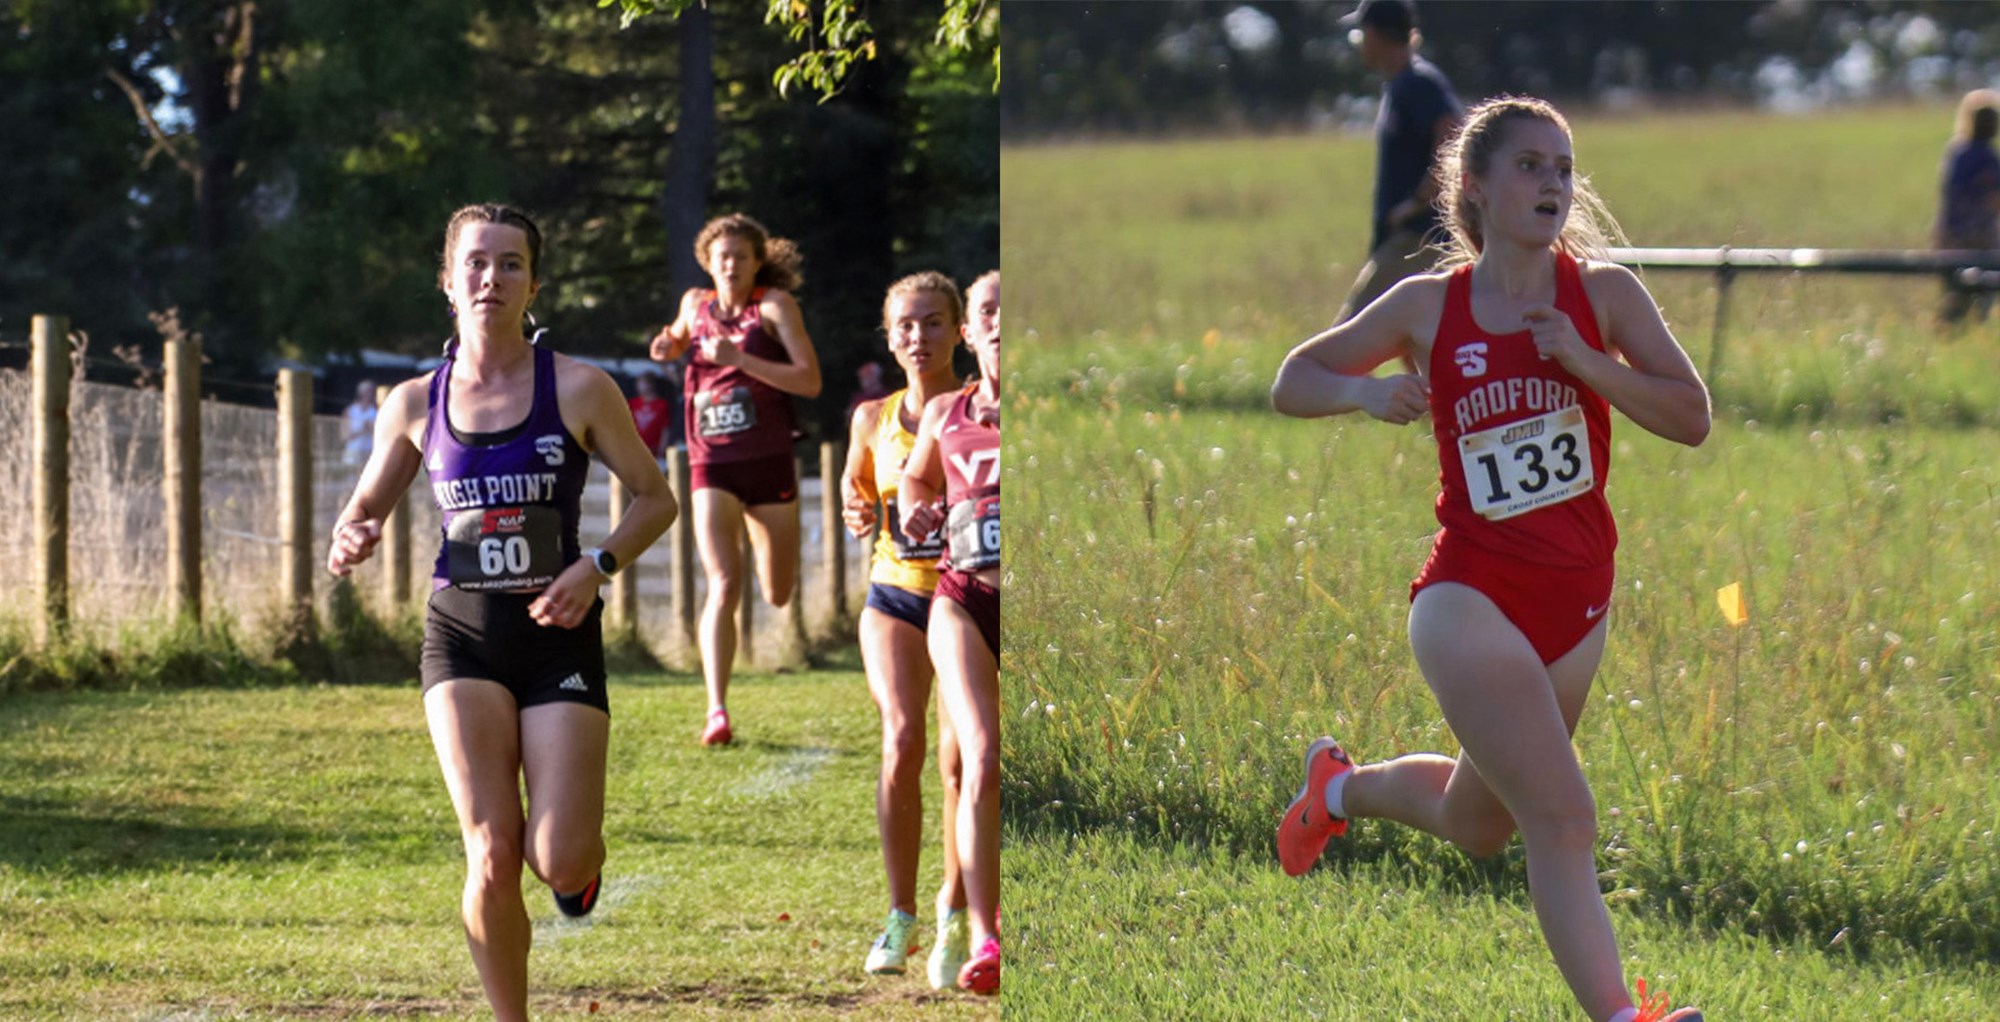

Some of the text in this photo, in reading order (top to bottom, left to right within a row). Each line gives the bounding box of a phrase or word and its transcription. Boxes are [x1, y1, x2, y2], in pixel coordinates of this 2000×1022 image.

[705, 403, 745, 428] 155
[1455, 377, 1577, 434] RADFORD
[1502, 419, 1544, 444] JMU
[1477, 433, 1581, 503] 133
[485, 473, 556, 505] POINT
[1508, 488, 1569, 512] CROSS COUNTRY
[479, 536, 530, 576] 60
